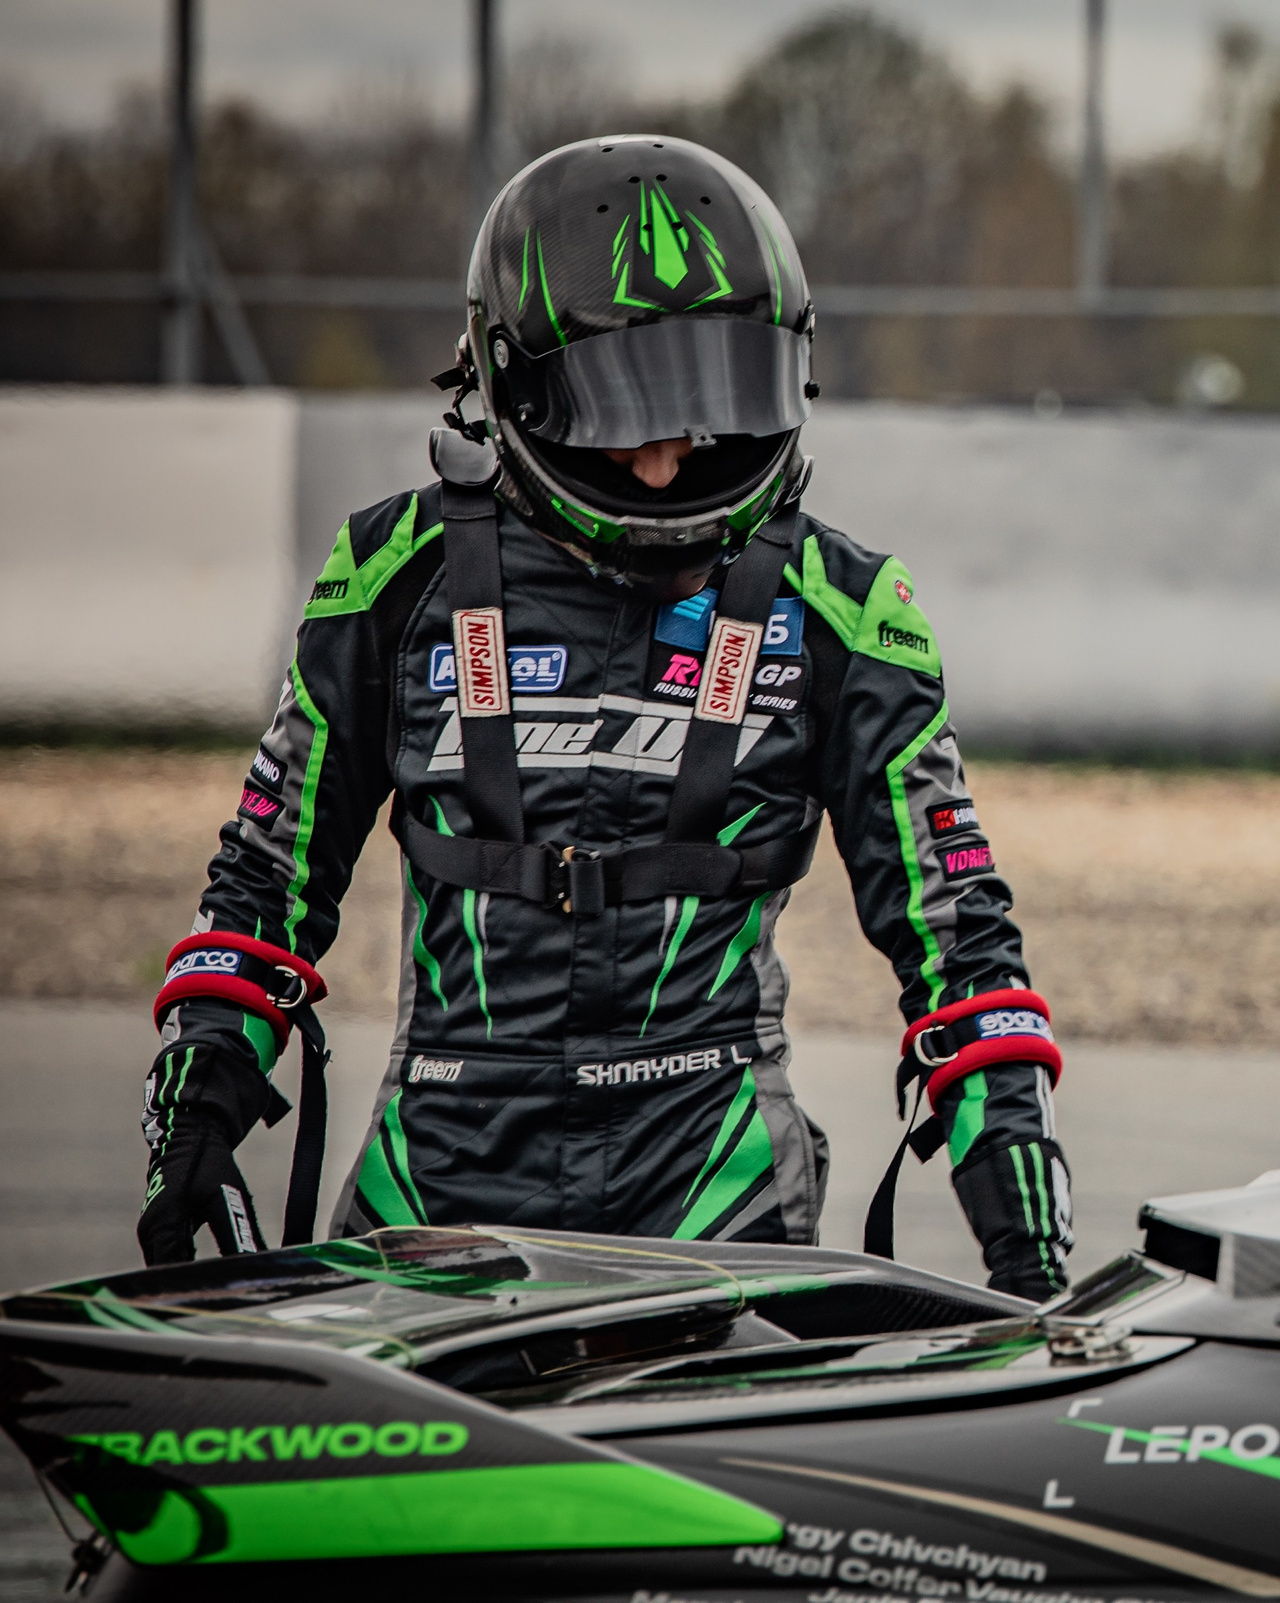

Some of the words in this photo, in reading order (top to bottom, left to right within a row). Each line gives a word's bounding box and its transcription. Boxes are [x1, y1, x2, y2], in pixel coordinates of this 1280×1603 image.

[878, 620, 929, 654] freem
[435, 655, 558, 682] AOL
[468, 621, 495, 706] SIMPSON
[709, 632, 747, 713] SIMPSON
[653, 682, 698, 699] RUSSI
[752, 694, 797, 711] SERIES
[165, 951, 238, 986] parco
[979, 1011, 1053, 1042] spar
[407, 1055, 464, 1083] freem
[576, 1049, 722, 1086] SHNAYDER
[64, 1420, 469, 1467] RACKWOOD
[850, 1528, 1048, 1582] Chivchyan
